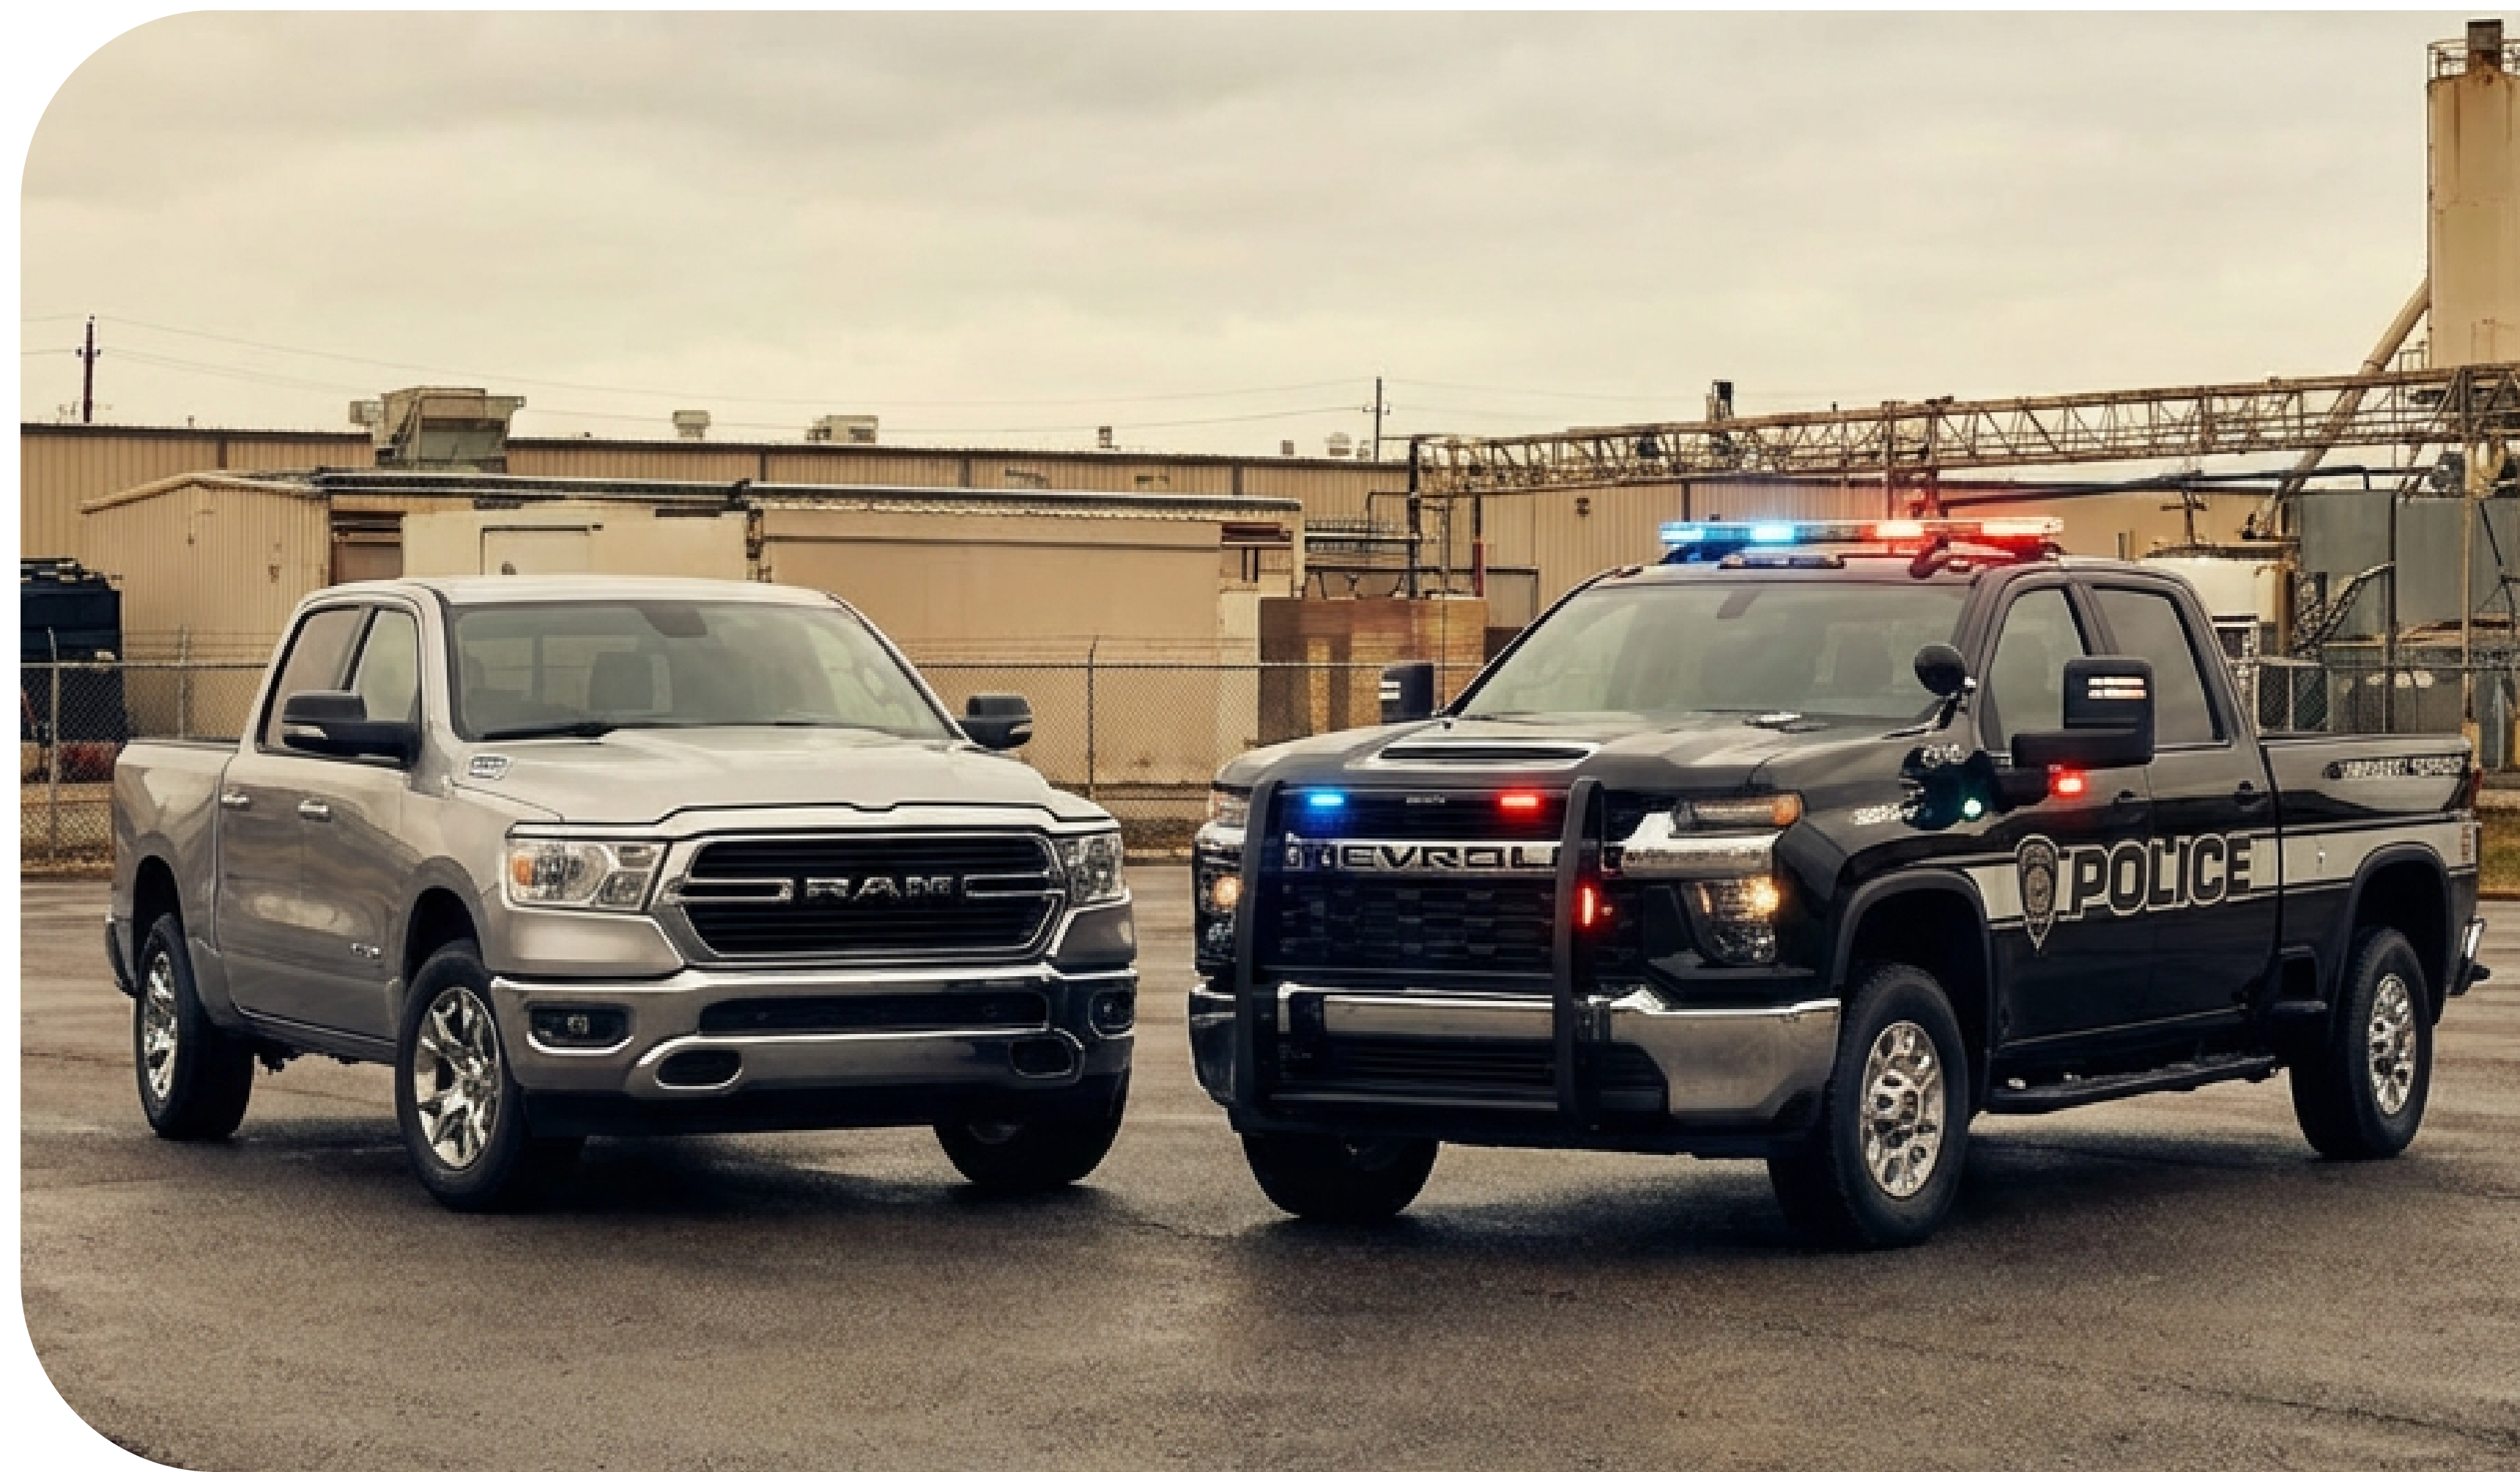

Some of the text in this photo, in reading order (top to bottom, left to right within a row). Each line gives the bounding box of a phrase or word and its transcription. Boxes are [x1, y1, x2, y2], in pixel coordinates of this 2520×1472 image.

[1286, 842, 1623, 870] EVROL
[805, 876, 954, 902] RAM
[2064, 833, 2253, 920] POLICE
